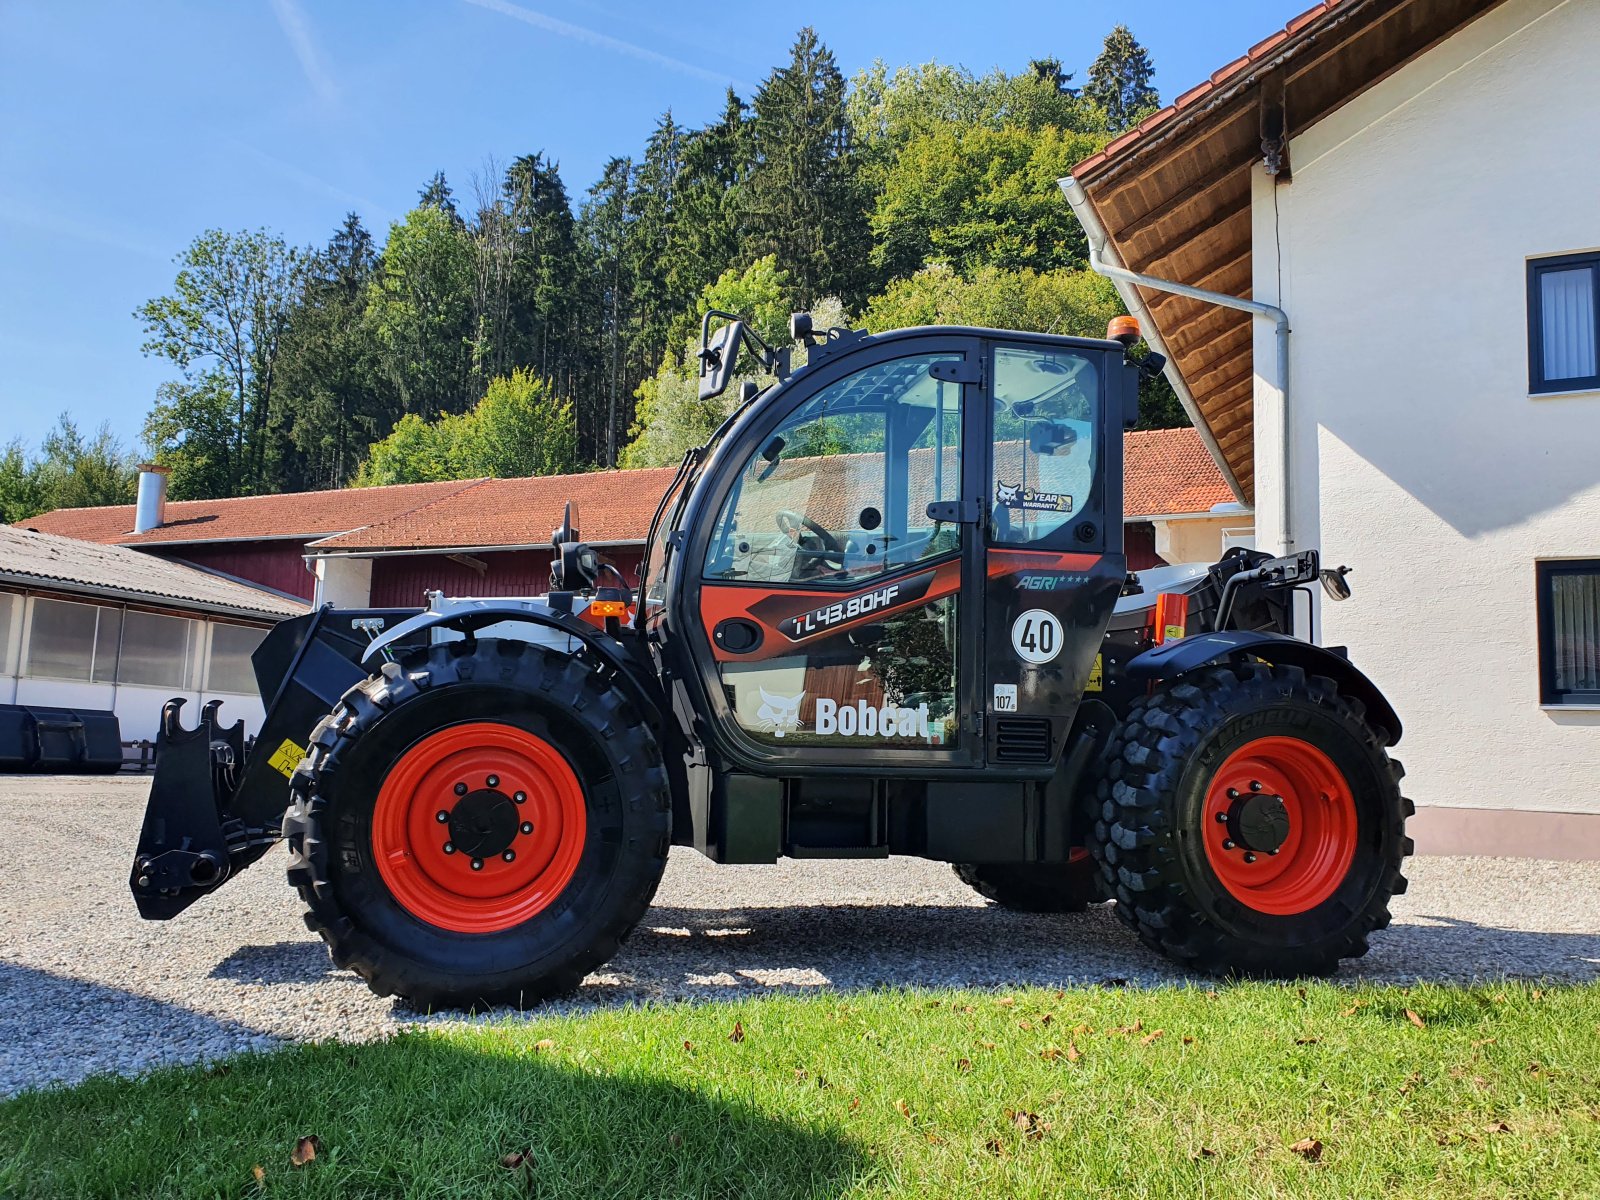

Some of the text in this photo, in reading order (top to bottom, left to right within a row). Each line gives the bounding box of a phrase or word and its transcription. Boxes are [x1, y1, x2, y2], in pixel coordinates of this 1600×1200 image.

[1023, 488, 1058, 503] 3 YEAR
[1022, 501, 1057, 509] WARRANTY
[1015, 575, 1059, 590] AGRI
[1020, 619, 1053, 654] 40
[995, 695, 1011, 709] 107
[815, 698, 929, 738] Bobcat
[1218, 708, 1312, 748] MICHELIN
